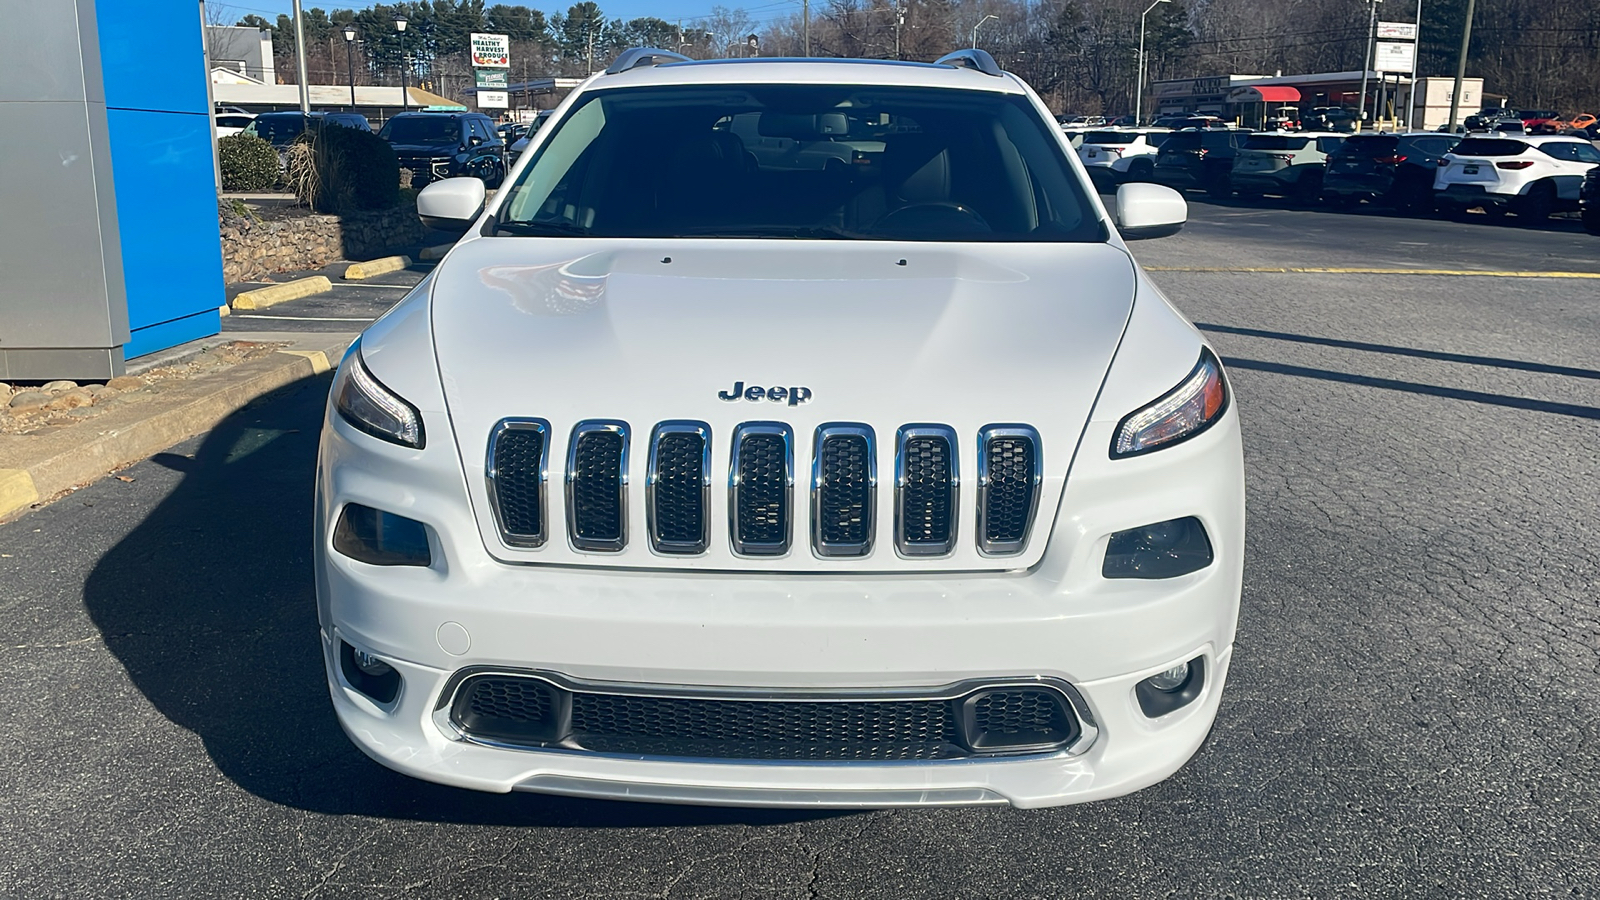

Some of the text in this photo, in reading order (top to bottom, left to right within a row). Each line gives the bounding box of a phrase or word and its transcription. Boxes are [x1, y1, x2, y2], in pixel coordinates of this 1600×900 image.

[1195, 79, 1221, 87] AUTO
[1191, 87, 1220, 95] MART
[718, 381, 812, 407] Jeep
